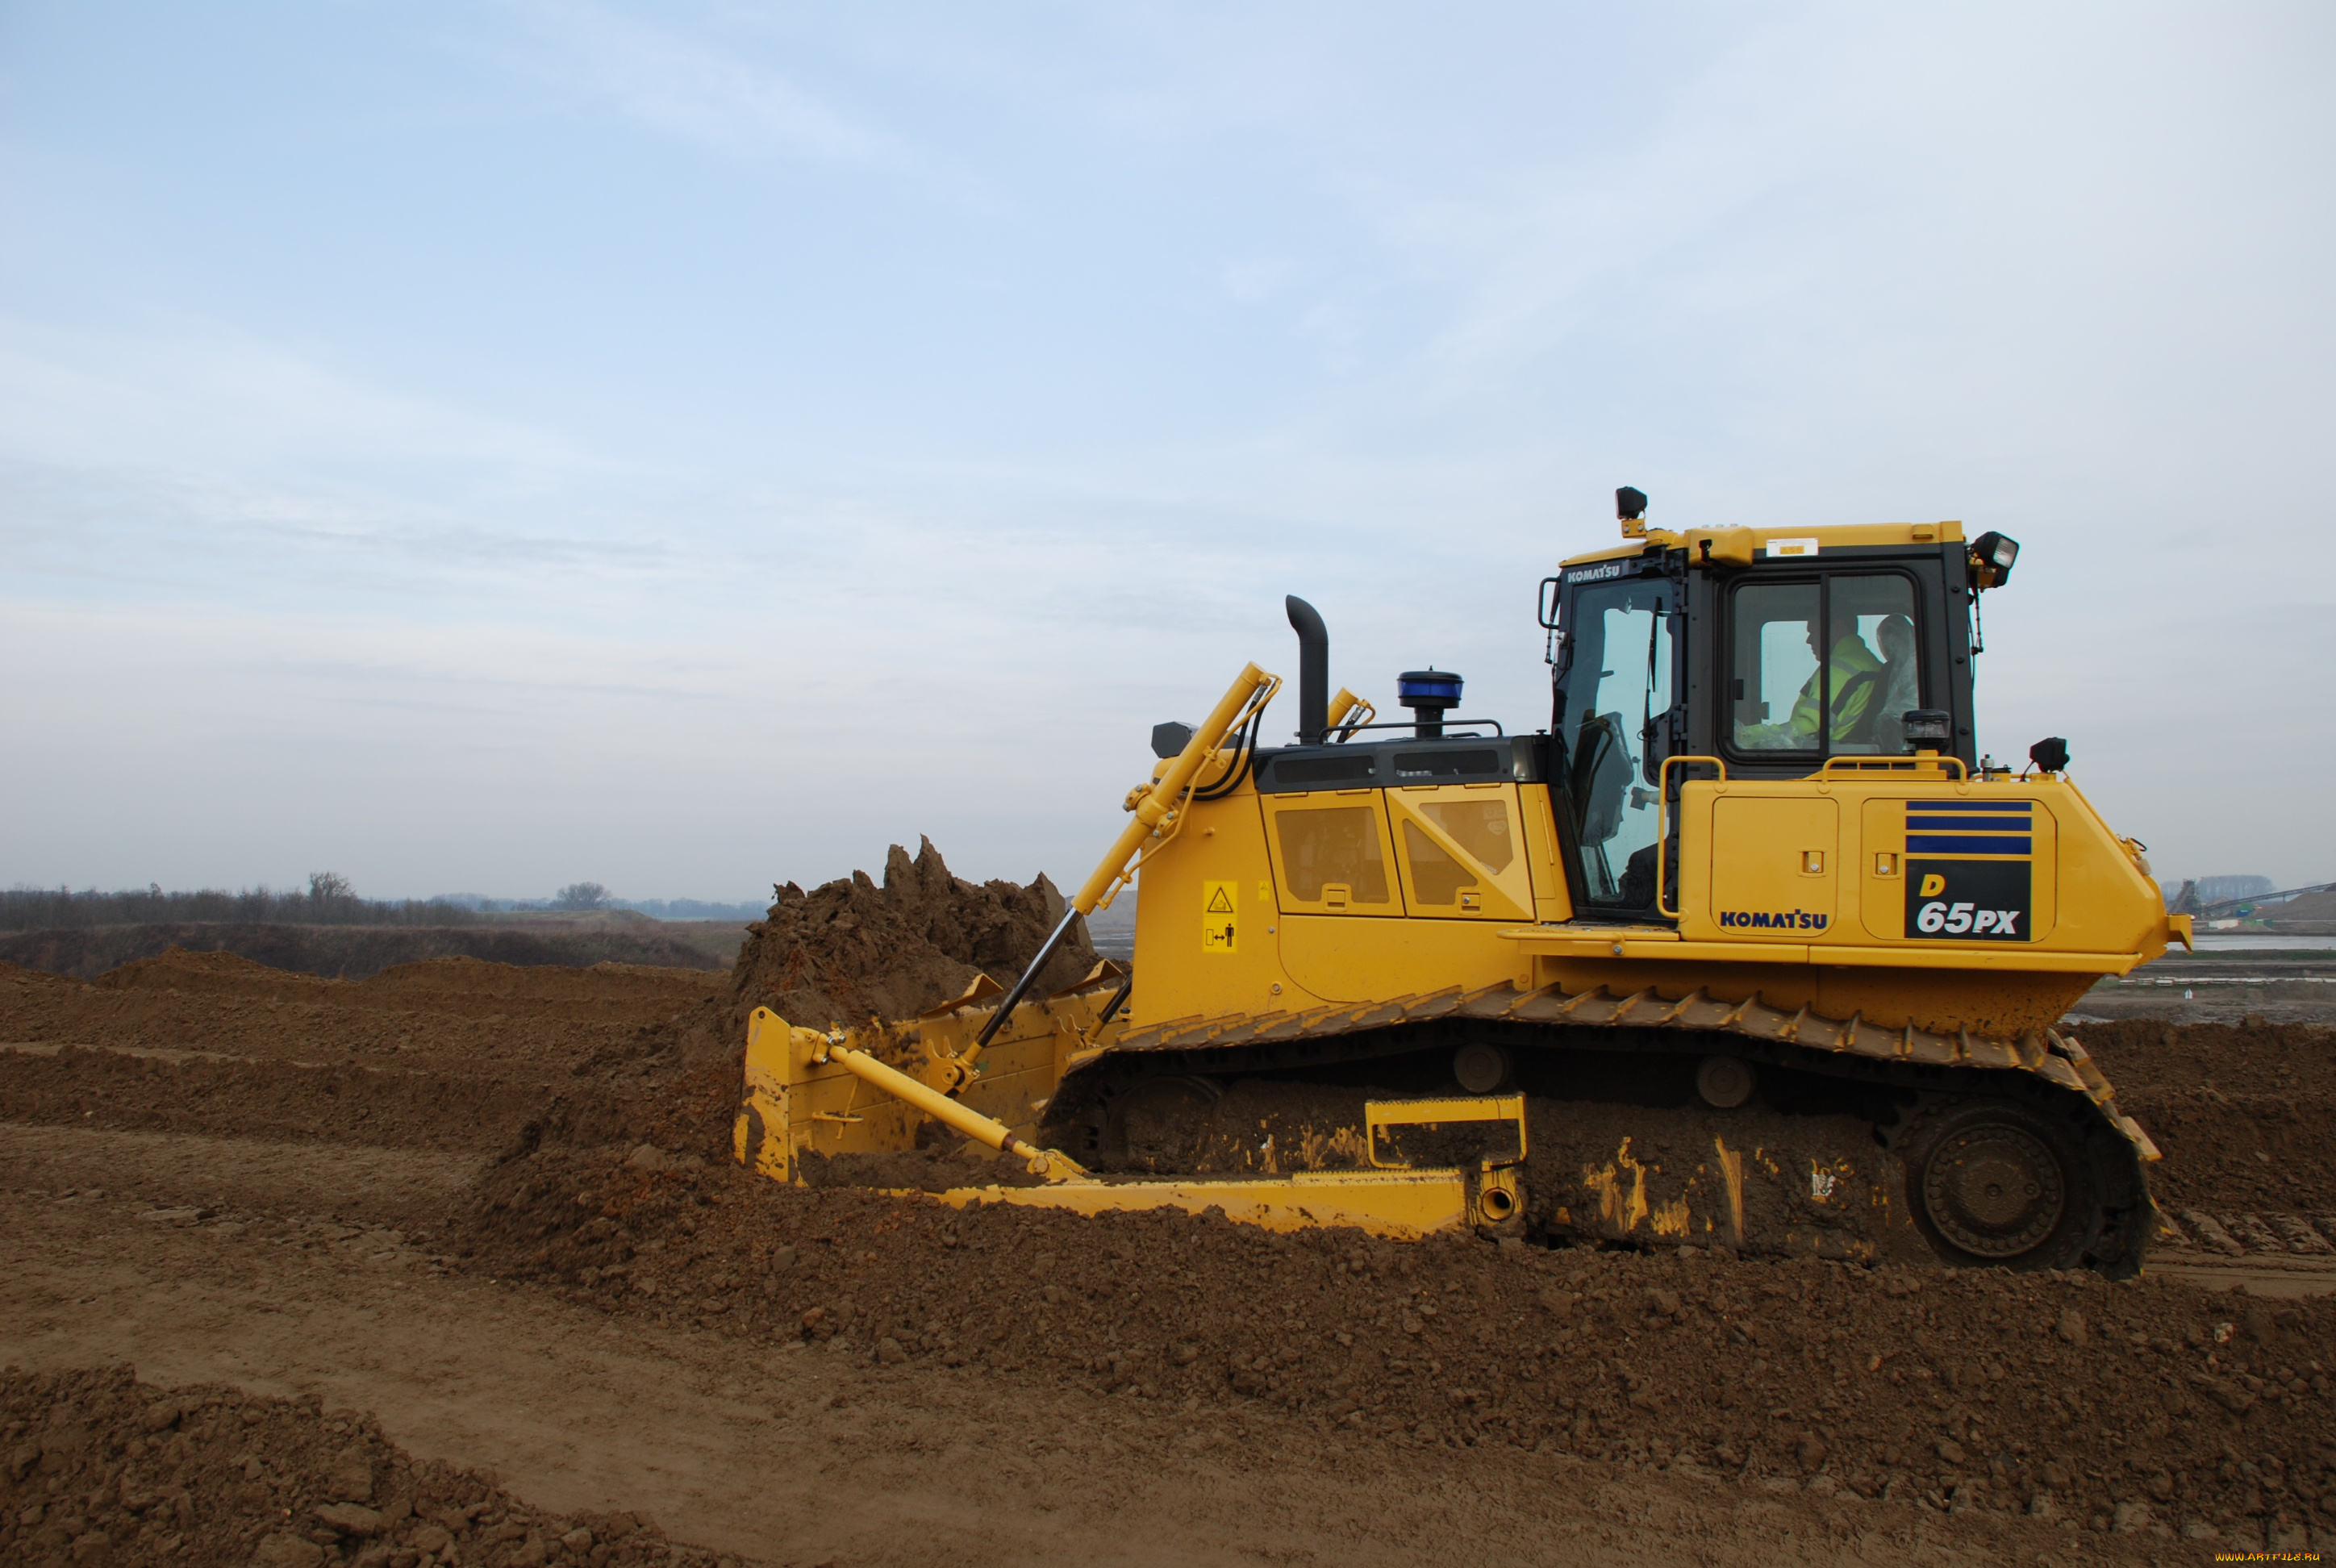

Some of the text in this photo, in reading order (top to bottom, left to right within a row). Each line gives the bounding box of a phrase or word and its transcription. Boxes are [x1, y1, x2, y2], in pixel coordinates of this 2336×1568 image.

[1567, 565, 1620, 582] KOMATSU
[1919, 874, 1946, 897] D
[1720, 908, 1827, 929] KOMATSU
[1917, 902, 2021, 934] 65PX
